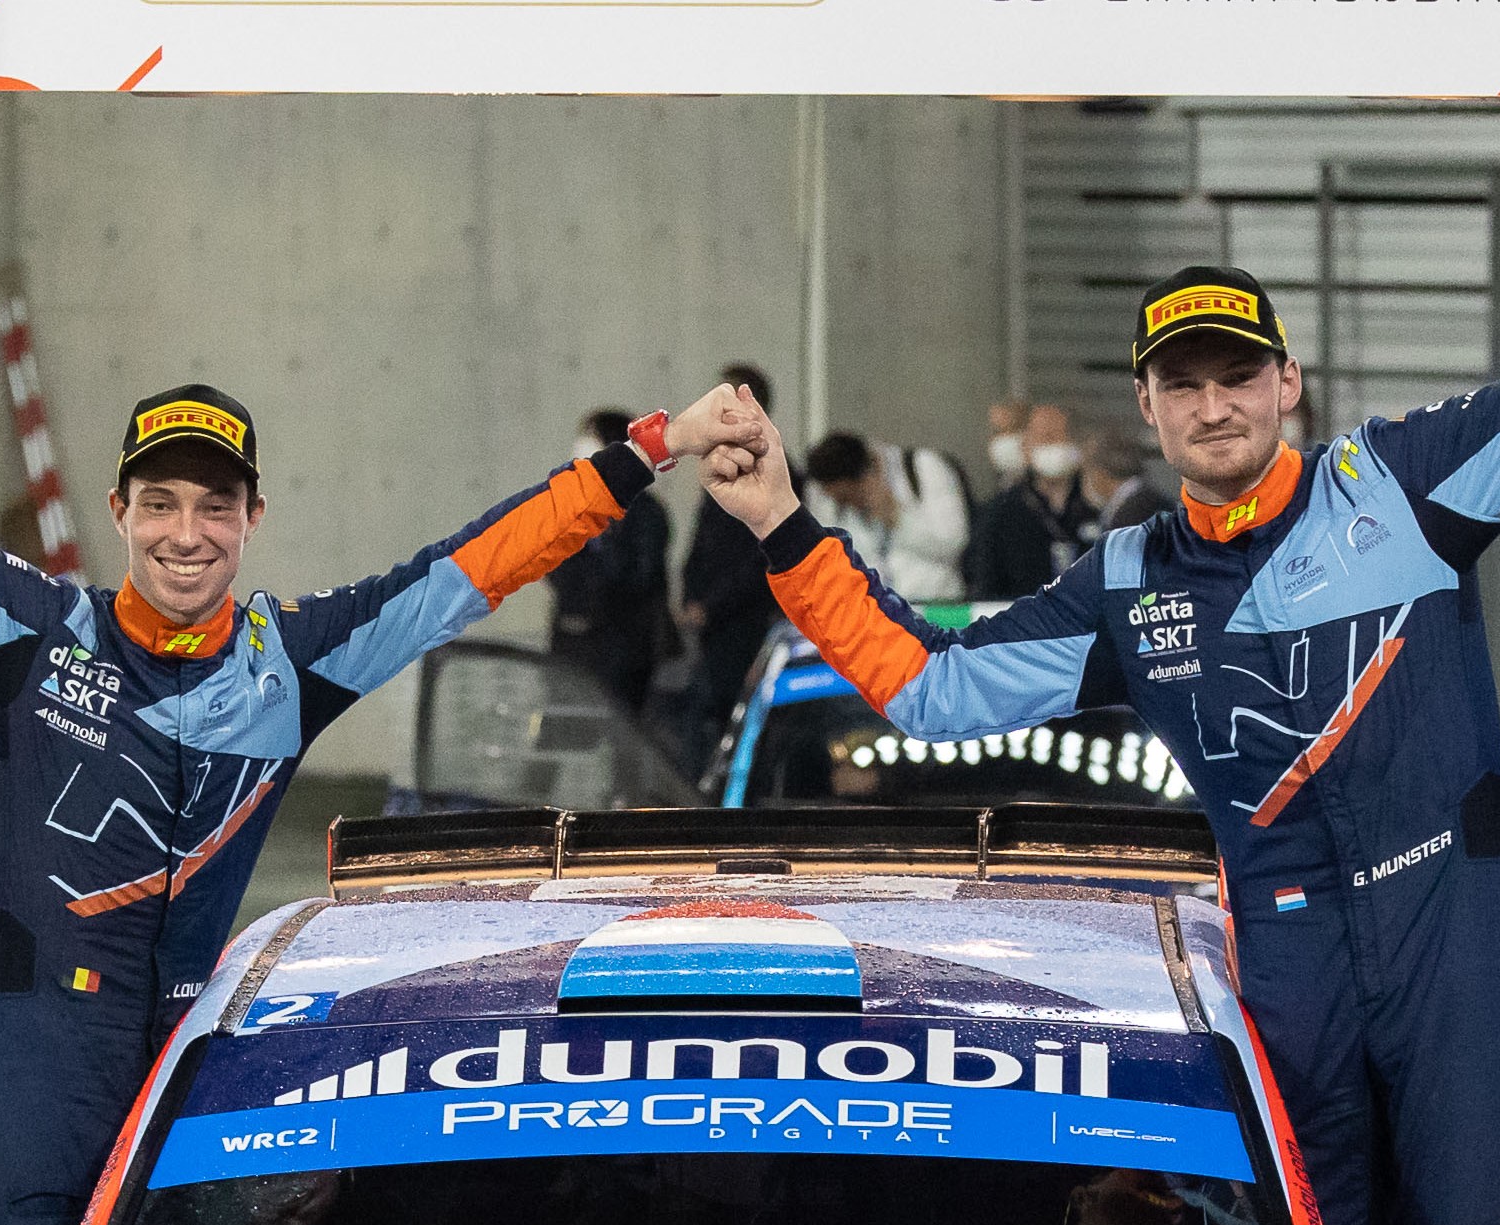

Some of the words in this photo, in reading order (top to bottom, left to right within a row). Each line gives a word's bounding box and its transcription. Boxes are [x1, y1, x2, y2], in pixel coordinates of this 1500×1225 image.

[1152, 292, 1250, 326] PIRELLI
[142, 406, 240, 442] PIRELLI
[1284, 564, 1325, 592] HYUNDAI
[1152, 624, 1197, 651] SKT
[1155, 658, 1201, 680] dumobil
[61, 679, 117, 717] SKT
[47, 709, 108, 747] dumobil
[1353, 871, 1369, 888] G.
[1372, 830, 1452, 882] MUNSTER
[429, 1028, 1109, 1098] dumobil
[221, 1127, 319, 1153] WRC2
[708, 1126, 950, 1145] DIGITAL
[1069, 1125, 1177, 1144] WRC.com
